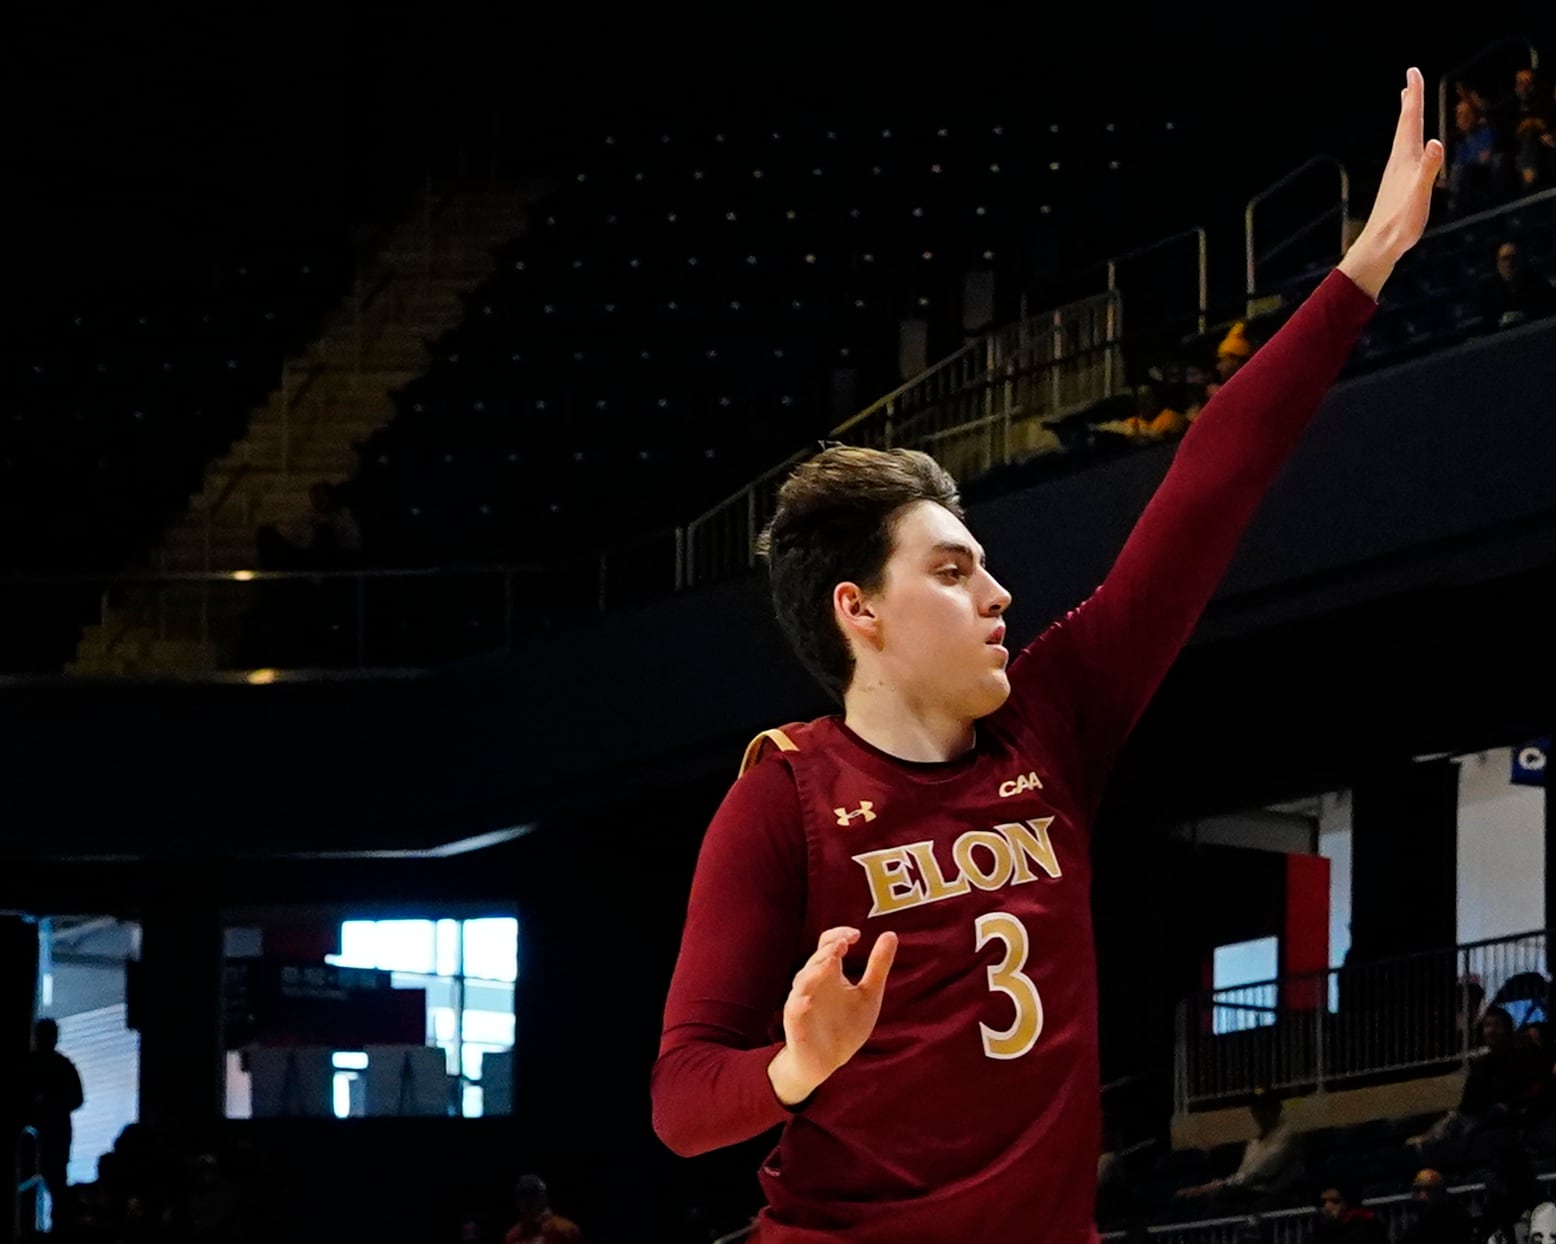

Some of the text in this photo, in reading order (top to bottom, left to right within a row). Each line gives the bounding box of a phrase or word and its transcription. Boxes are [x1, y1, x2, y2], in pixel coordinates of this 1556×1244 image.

[999, 771, 1043, 799] CAA
[851, 815, 1063, 919] ELON
[973, 911, 1044, 1060] 3
